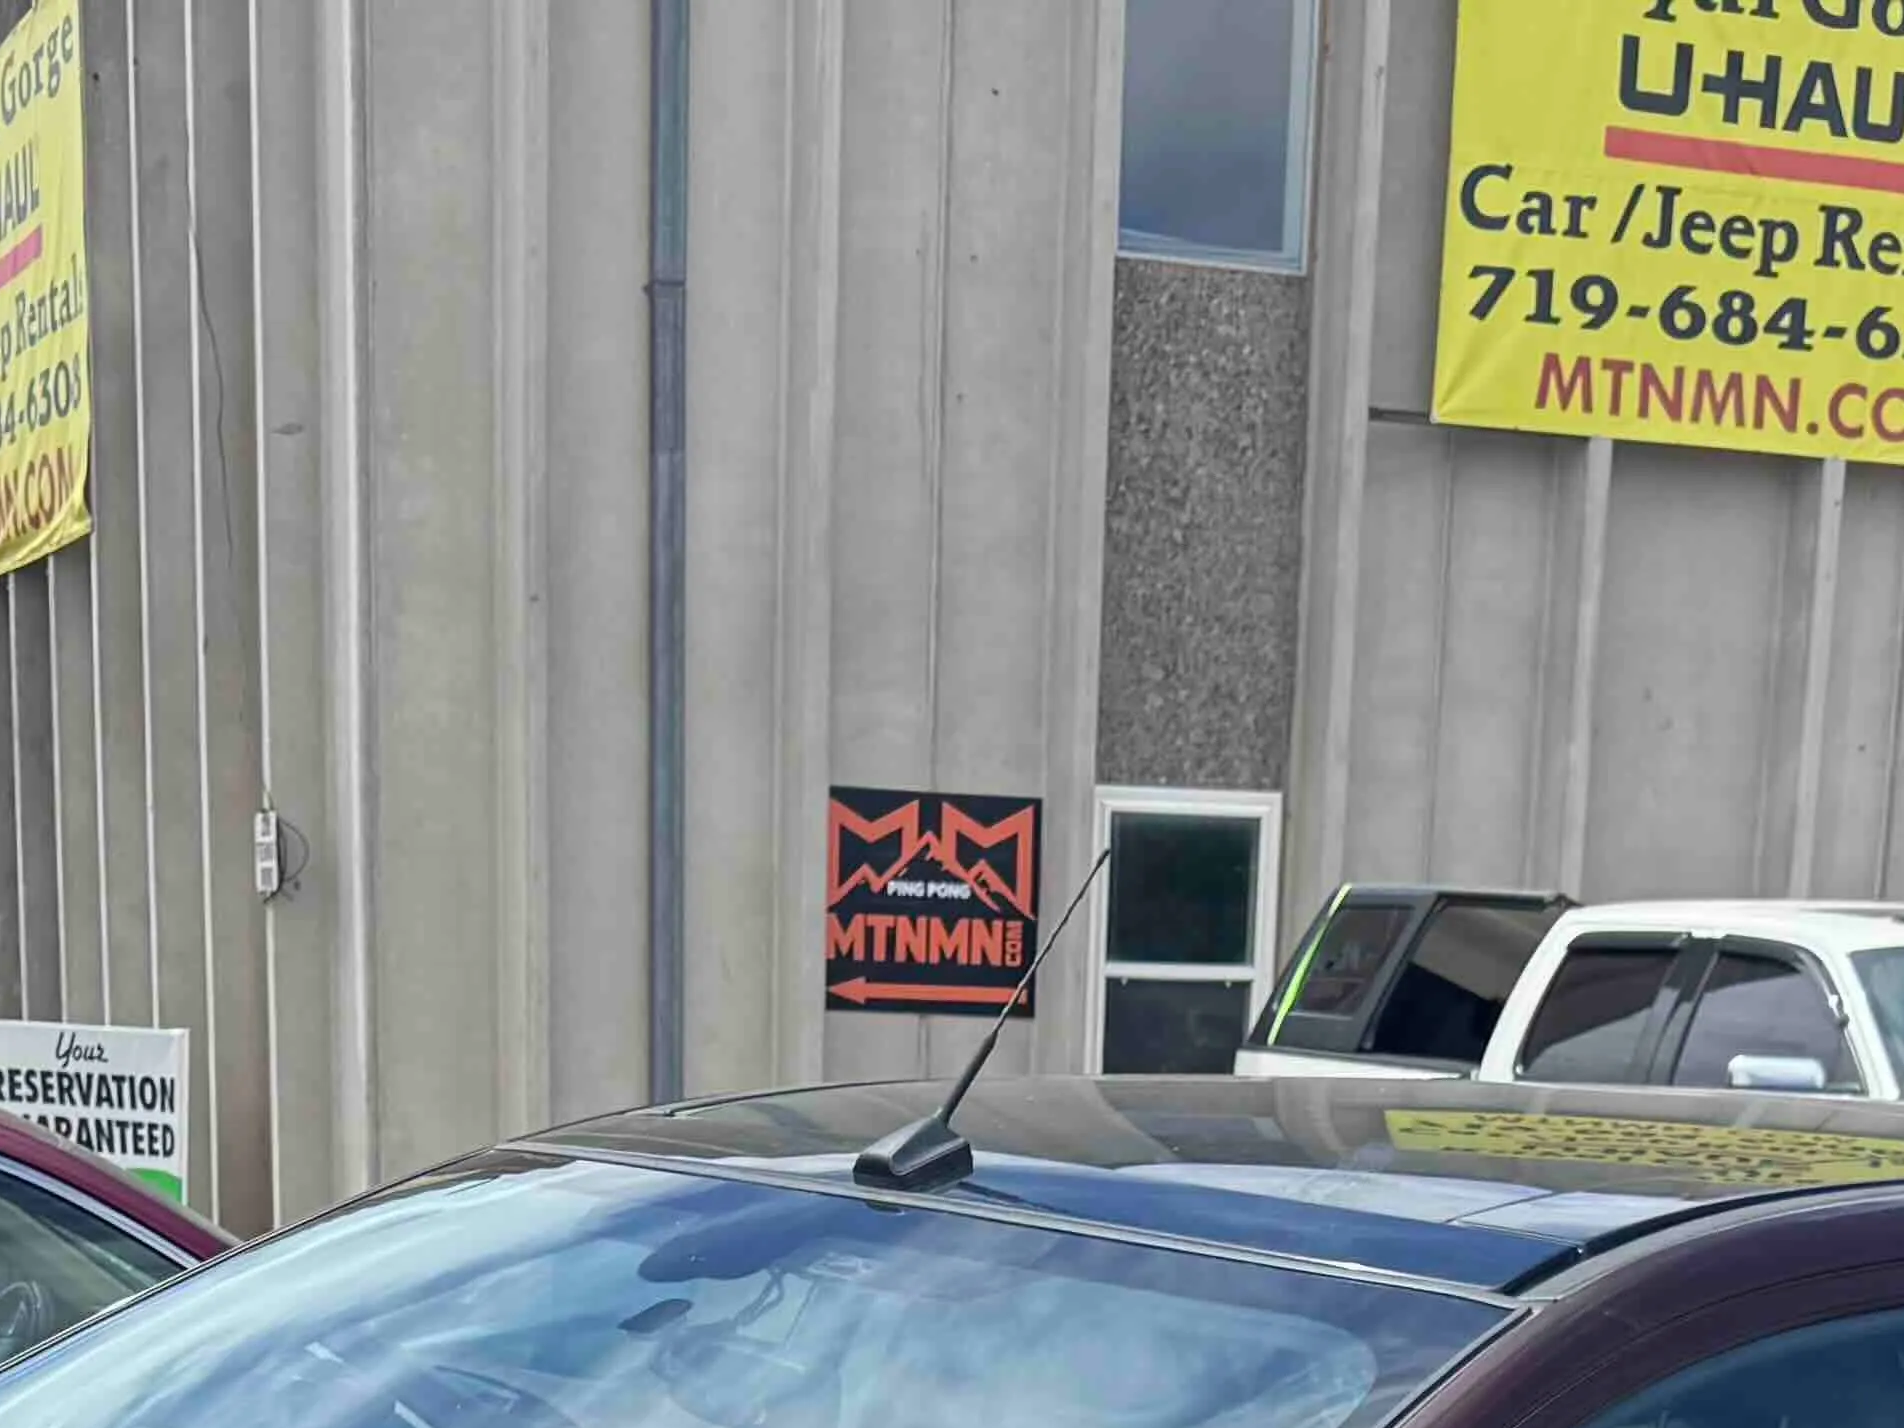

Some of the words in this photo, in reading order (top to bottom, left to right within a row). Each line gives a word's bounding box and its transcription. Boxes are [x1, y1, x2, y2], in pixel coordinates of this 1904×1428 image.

[1, 14, 74, 126] Gorge
[1459, 164, 1597, 238] Car
[826, 912, 1004, 967] MTNMN
[55, 1031, 109, 1068] Your
